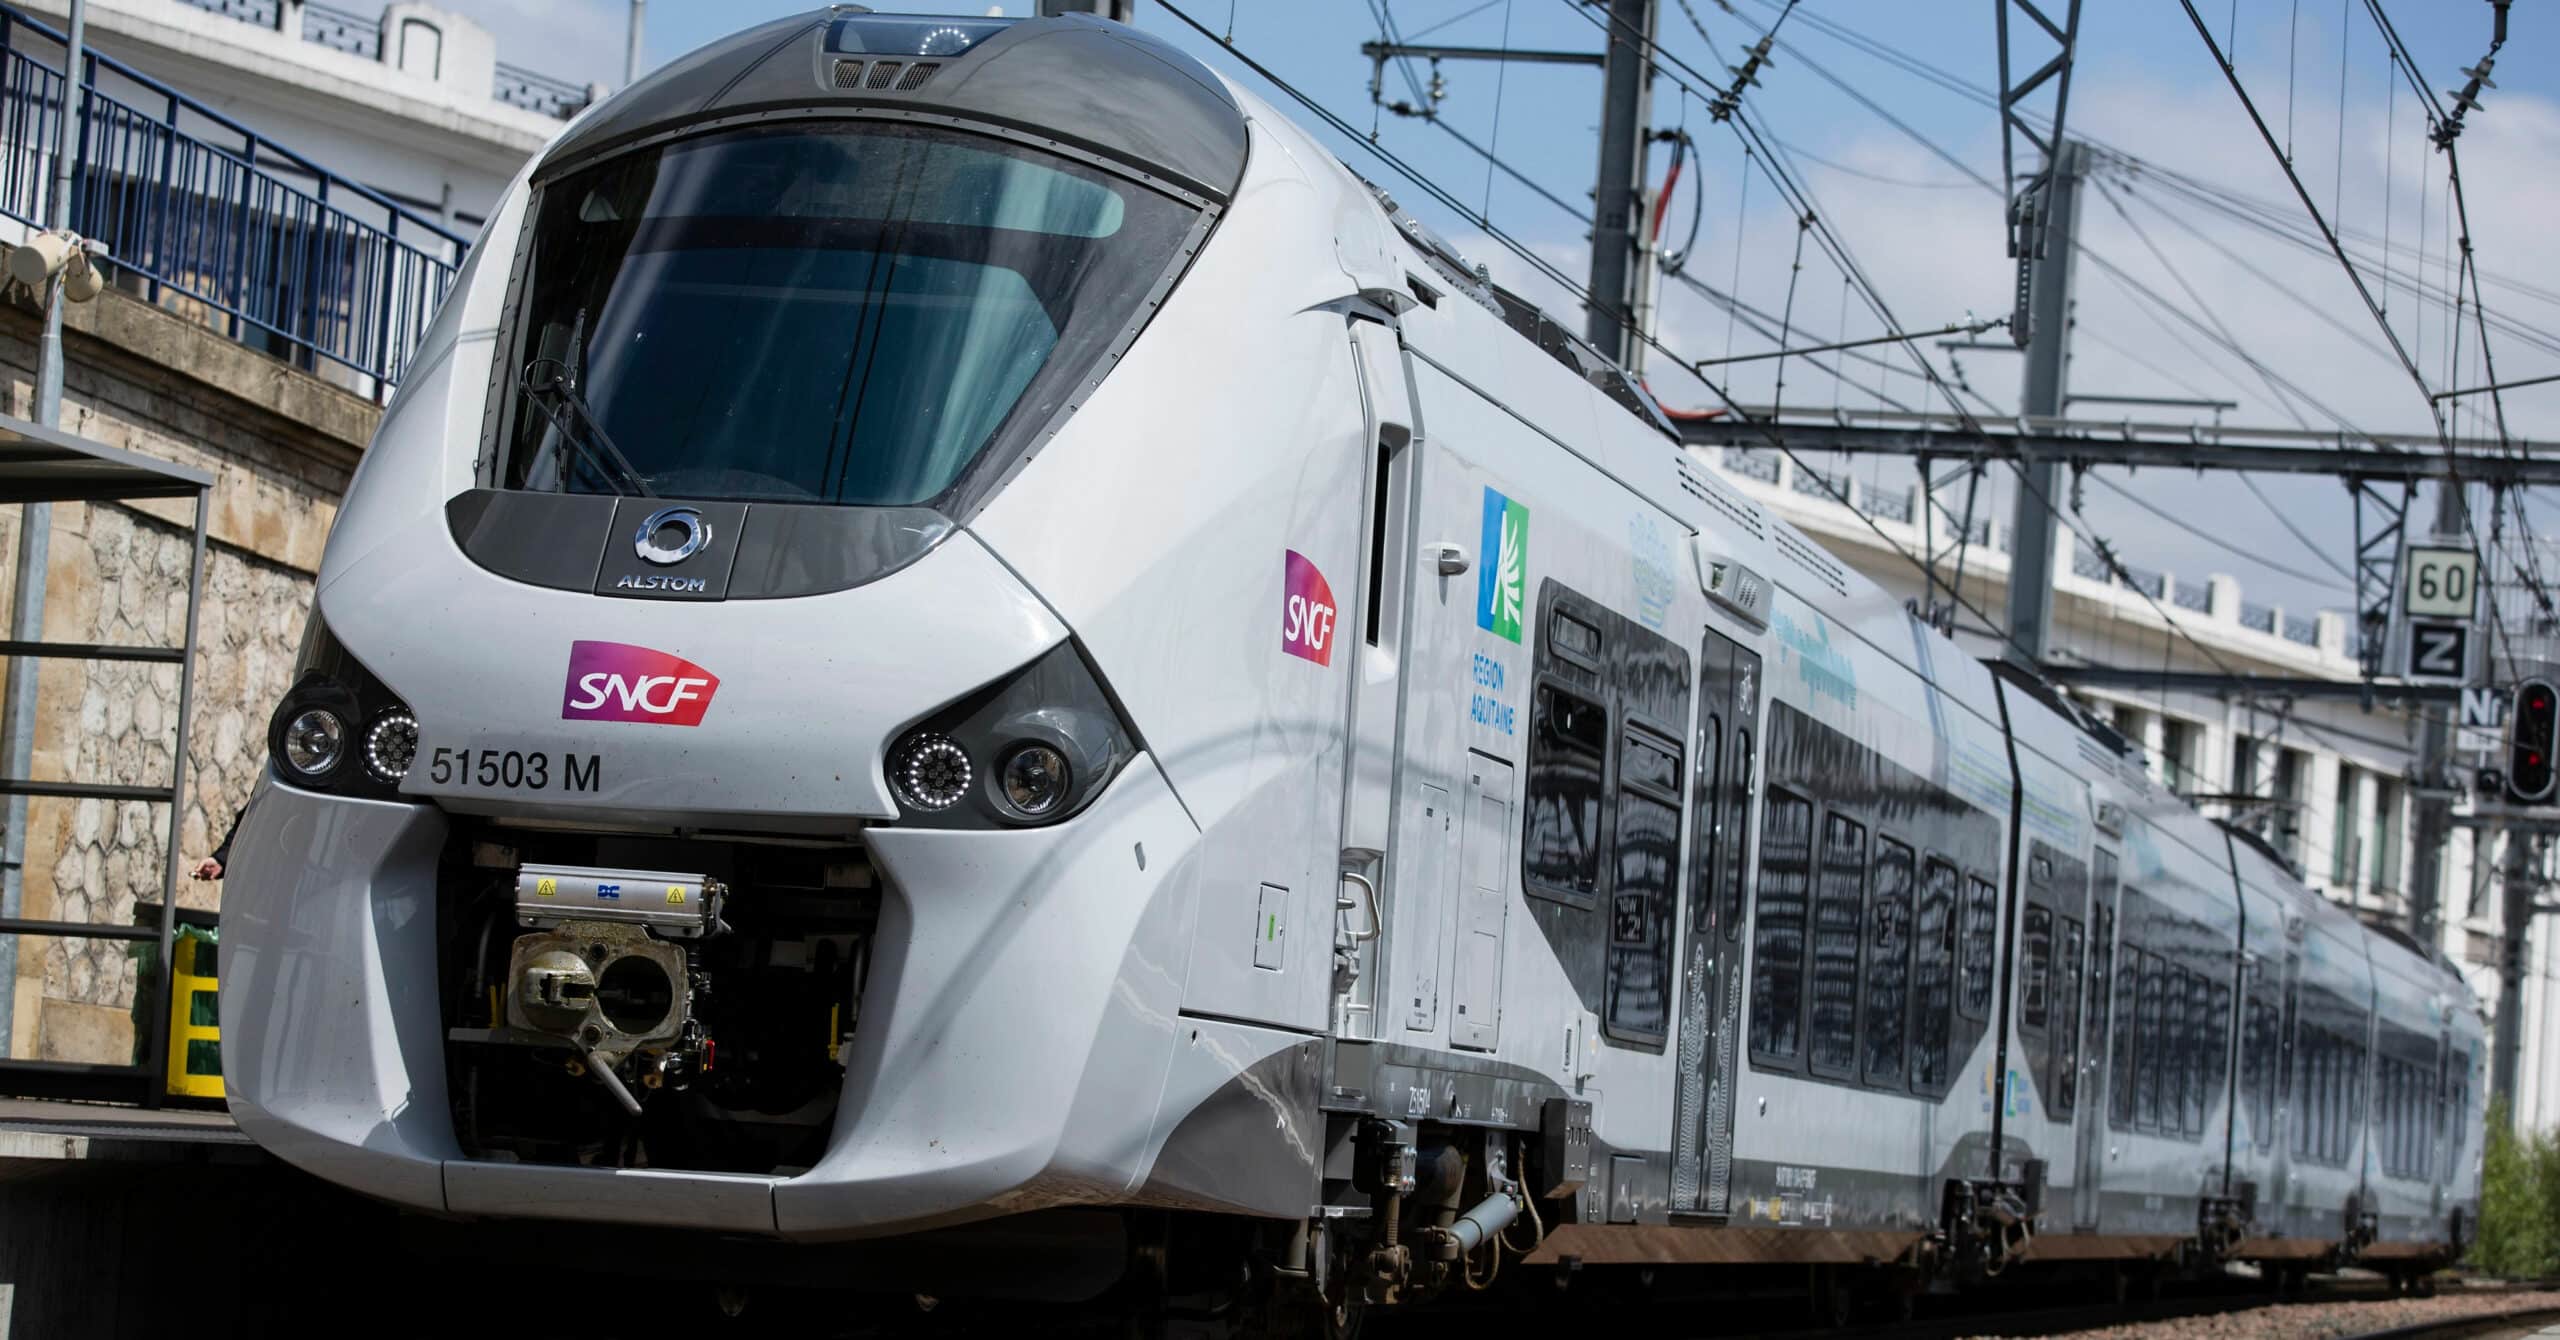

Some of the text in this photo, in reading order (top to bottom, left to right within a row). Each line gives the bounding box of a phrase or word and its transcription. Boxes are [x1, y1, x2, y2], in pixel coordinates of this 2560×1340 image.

[616, 575, 706, 592] ALSTOM
[2419, 563, 2465, 602] 60
[1285, 594, 1334, 650] SNCF
[2420, 632, 2457, 671] Z
[569, 672, 709, 714] SNCF
[1470, 692, 1515, 736] AQUITAINE
[430, 747, 601, 793] 51503 M
